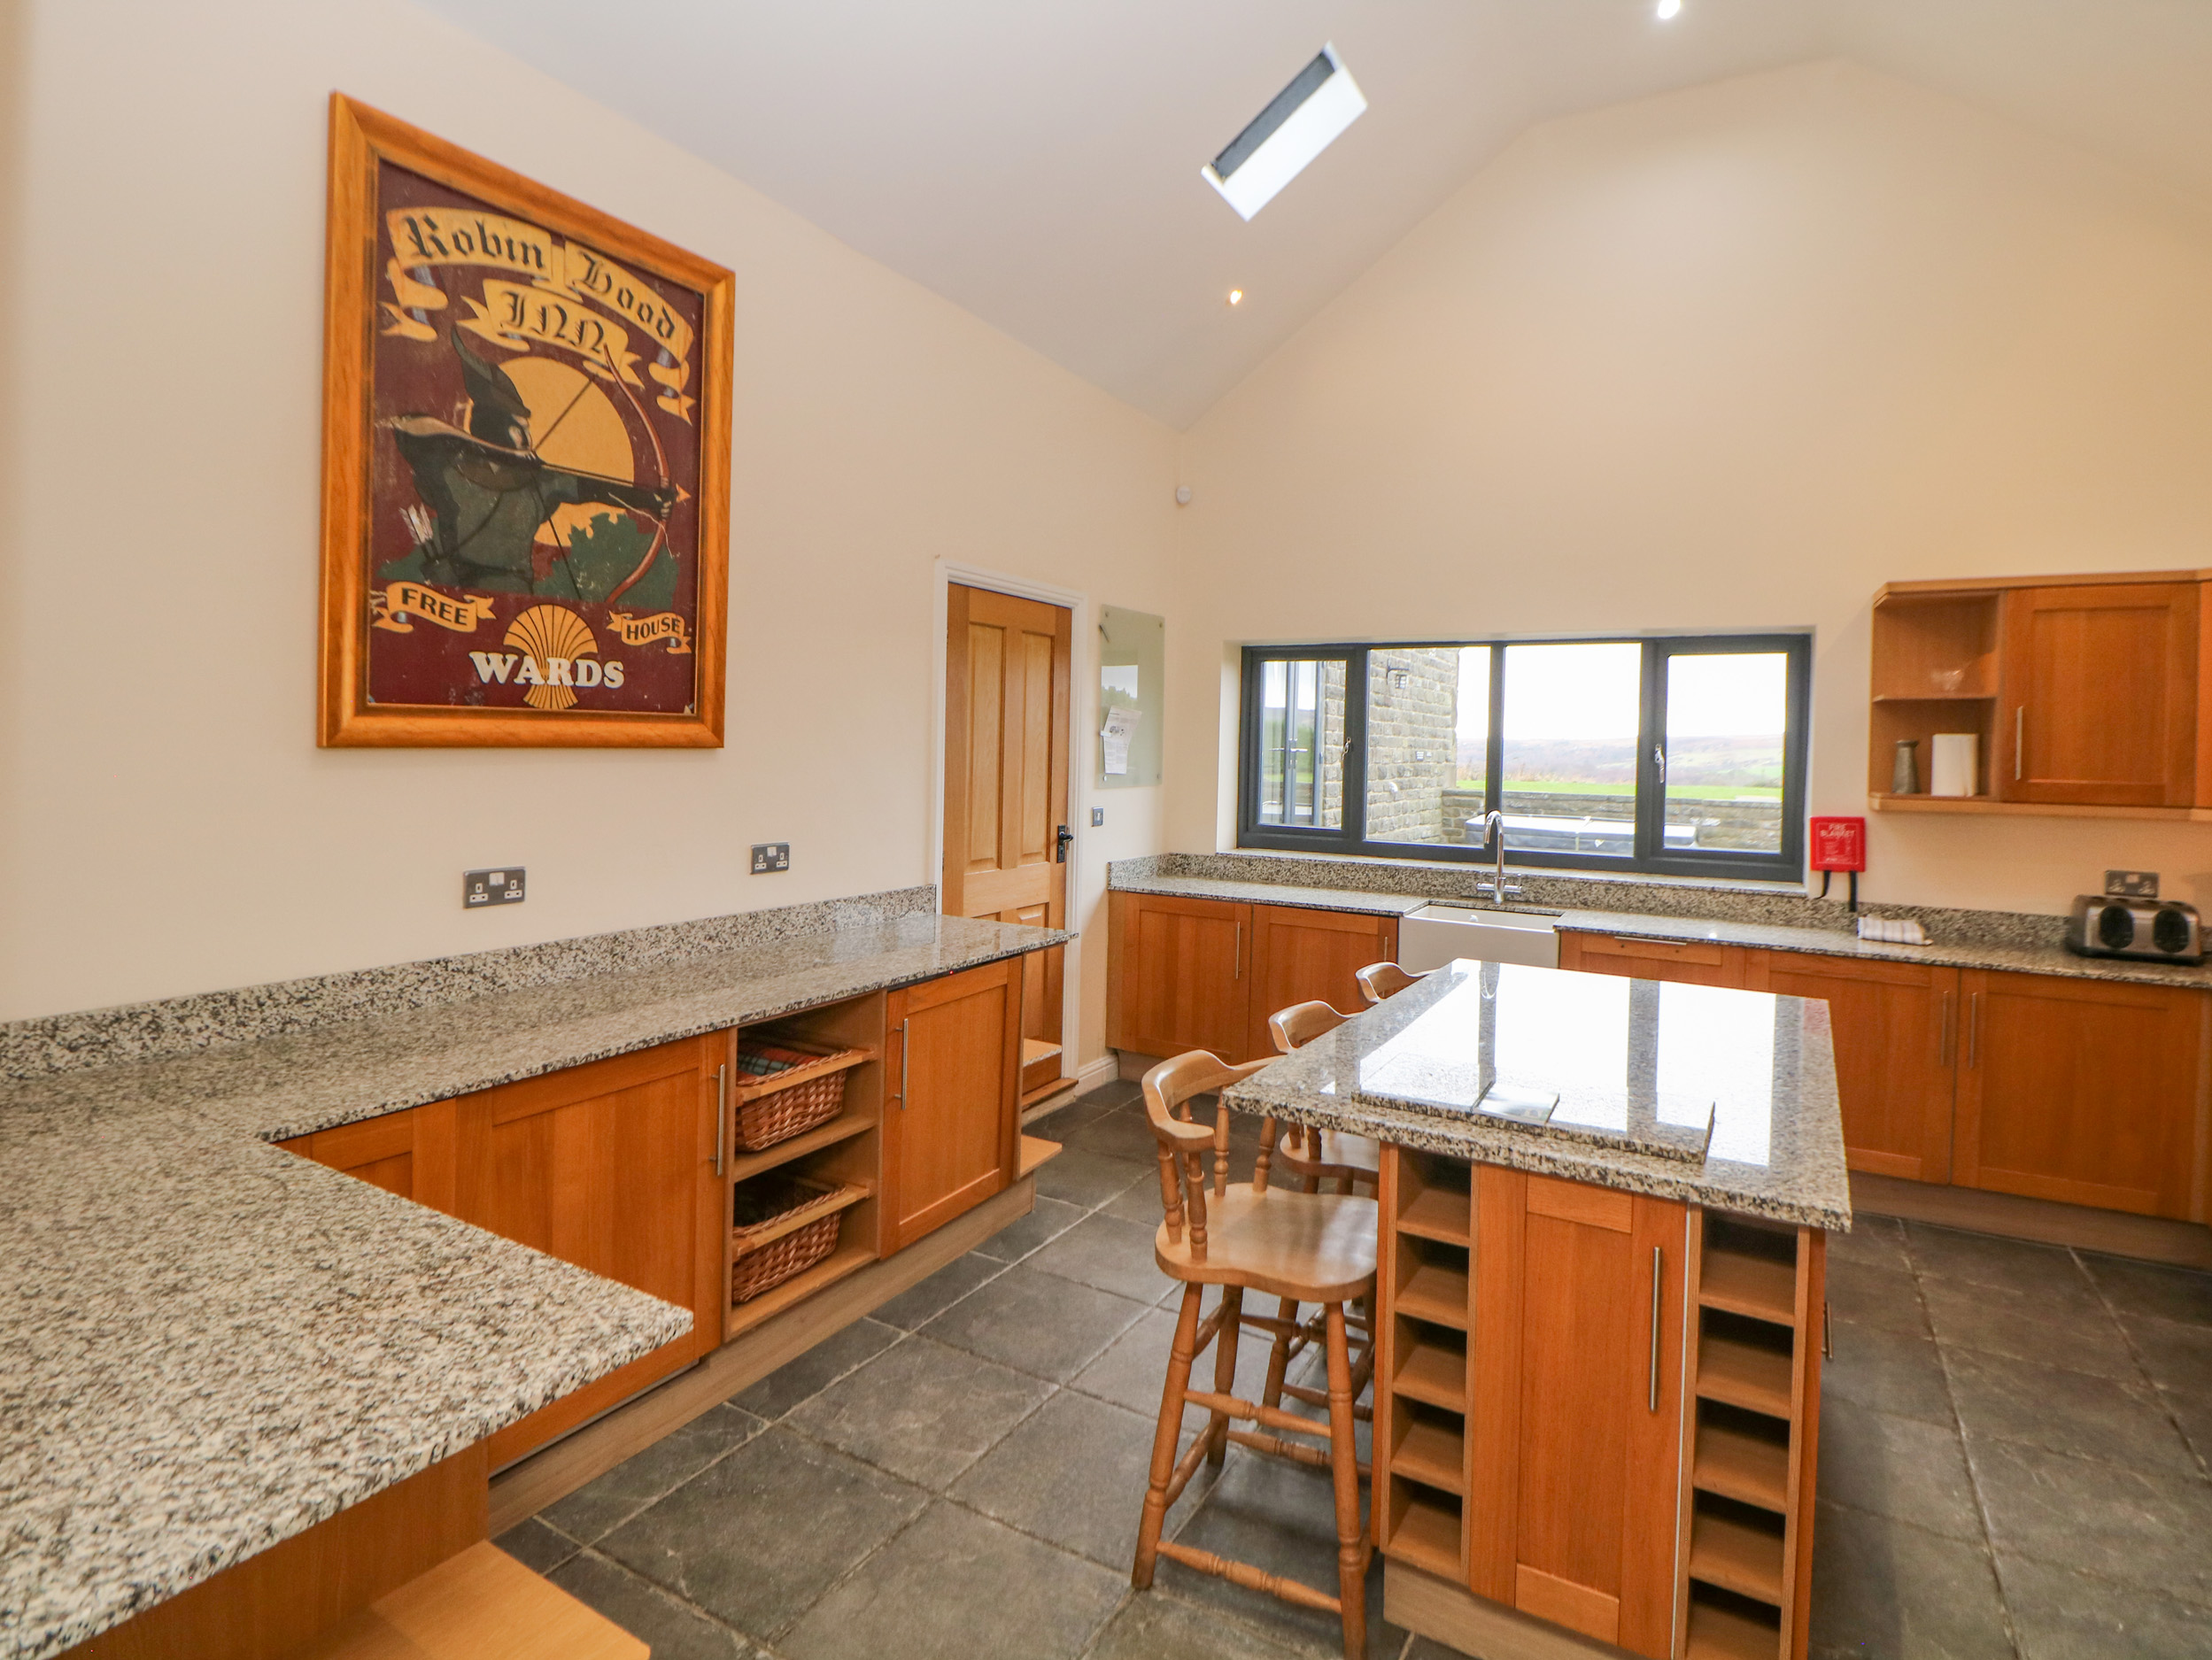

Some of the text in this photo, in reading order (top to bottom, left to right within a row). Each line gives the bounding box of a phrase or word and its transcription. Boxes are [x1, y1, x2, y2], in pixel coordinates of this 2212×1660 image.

[404, 214, 676, 340] Robin Hood
[401, 587, 681, 641] FREE HOUSE
[468, 652, 624, 689] WARDS
